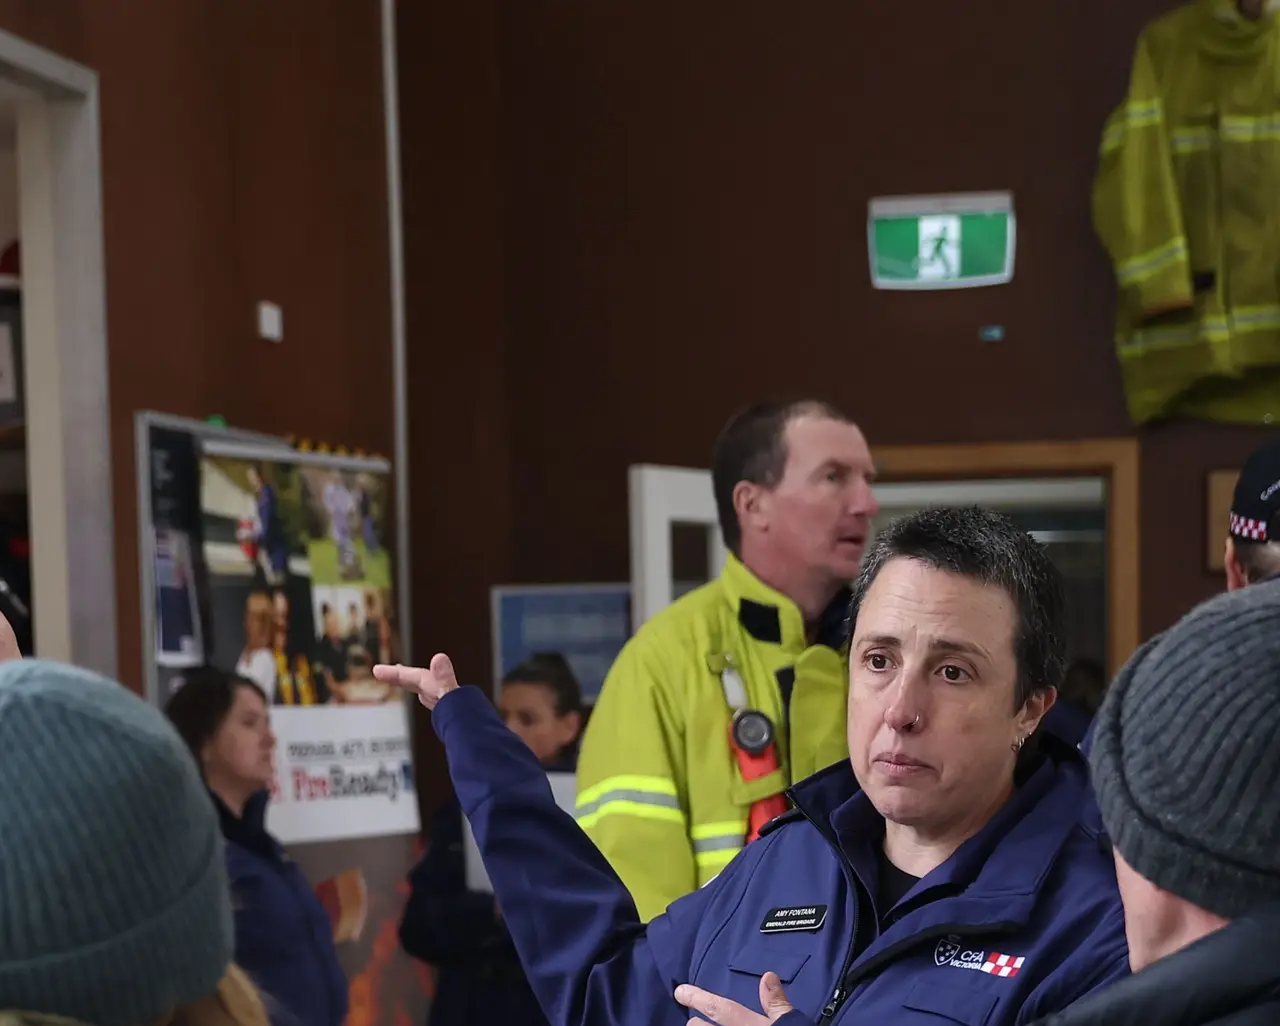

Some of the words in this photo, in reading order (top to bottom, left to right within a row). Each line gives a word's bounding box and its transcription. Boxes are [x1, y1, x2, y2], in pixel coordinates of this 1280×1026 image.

[774, 909, 789, 918] AMY
[788, 907, 816, 917] FONTANA
[765, 920, 786, 928] EMERALD
[960, 949, 985, 963] CFA
[949, 958, 982, 971] VICTORIA
